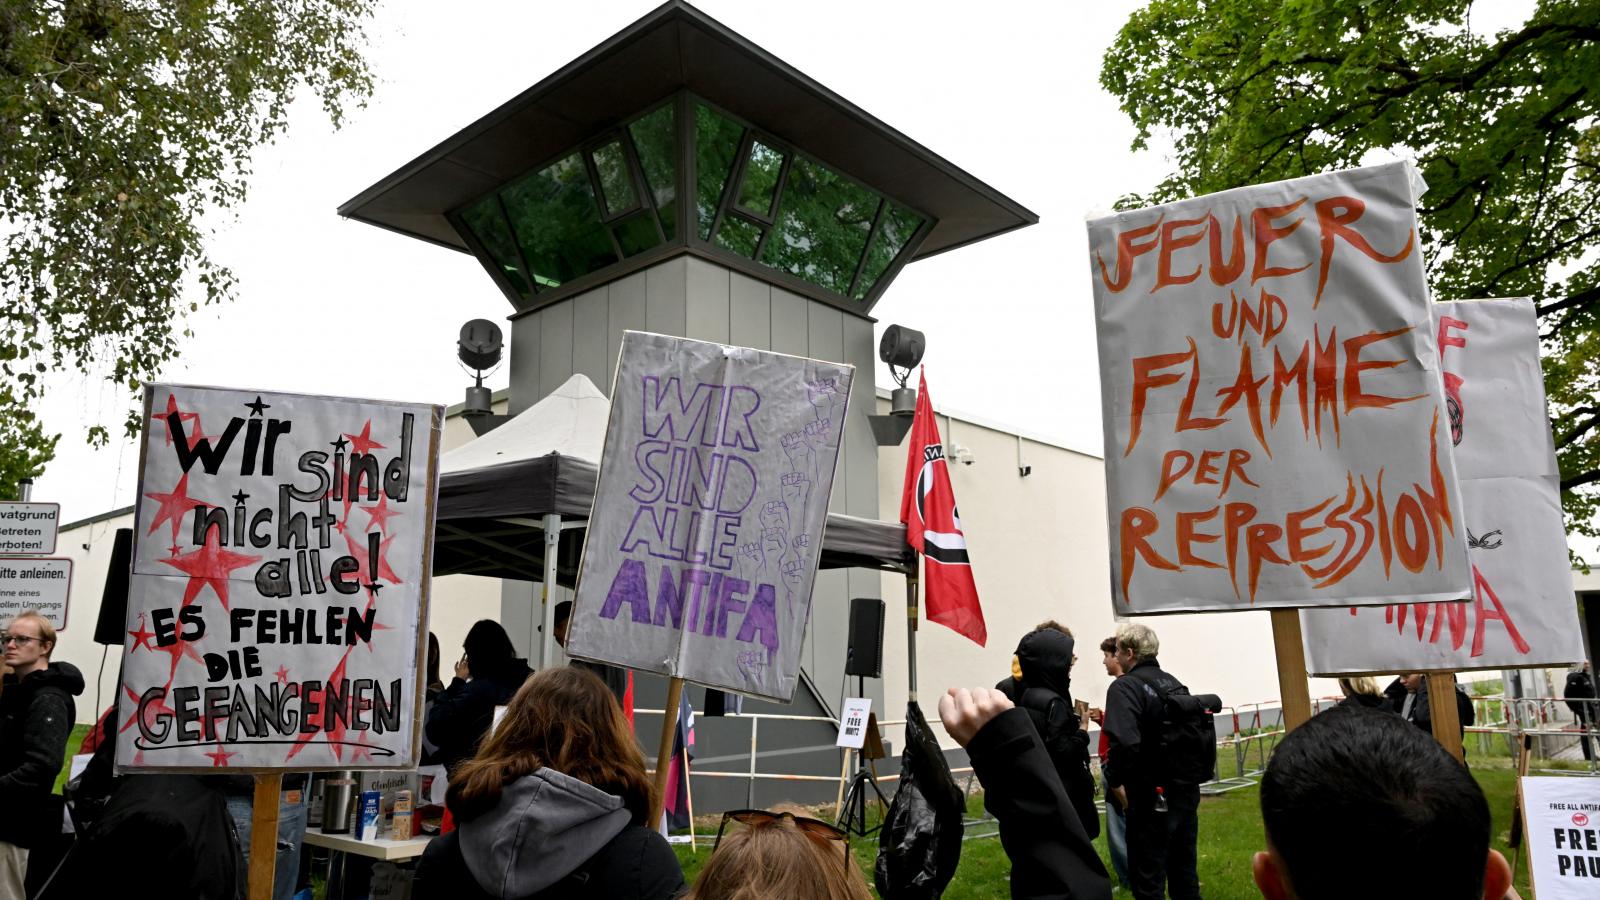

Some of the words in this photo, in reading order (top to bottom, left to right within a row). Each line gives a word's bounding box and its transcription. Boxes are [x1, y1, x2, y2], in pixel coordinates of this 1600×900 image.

[1097, 195, 1414, 310] FEUER
[1212, 288, 1288, 347] UND
[642, 376, 760, 451] WIR
[1124, 323, 1430, 460] FLAMME
[167, 395, 292, 476] Wir
[297, 412, 414, 502] sind
[628, 439, 757, 515] SIND
[1153, 449, 1260, 502] DER
[0, 528, 41, 536] etreten
[192, 484, 336, 549] nicht
[1120, 405, 1454, 605] REPRESSION
[255, 531, 384, 598] alle!
[619, 506, 742, 571] ALLE
[18, 589, 40, 597] eines
[20, 567, 66, 579] anleinen.
[22, 601, 62, 610] Umgangs
[151, 605, 206, 648] ES
[230, 606, 376, 646] FEHLEN
[599, 558, 779, 660] ANTIFA
[203, 646, 262, 682] DIE
[137, 678, 402, 744] GEFANGENEN
[847, 718, 861, 726] FREE
[1554, 828, 1600, 851] FRE
[1557, 855, 1600, 878] PAU
